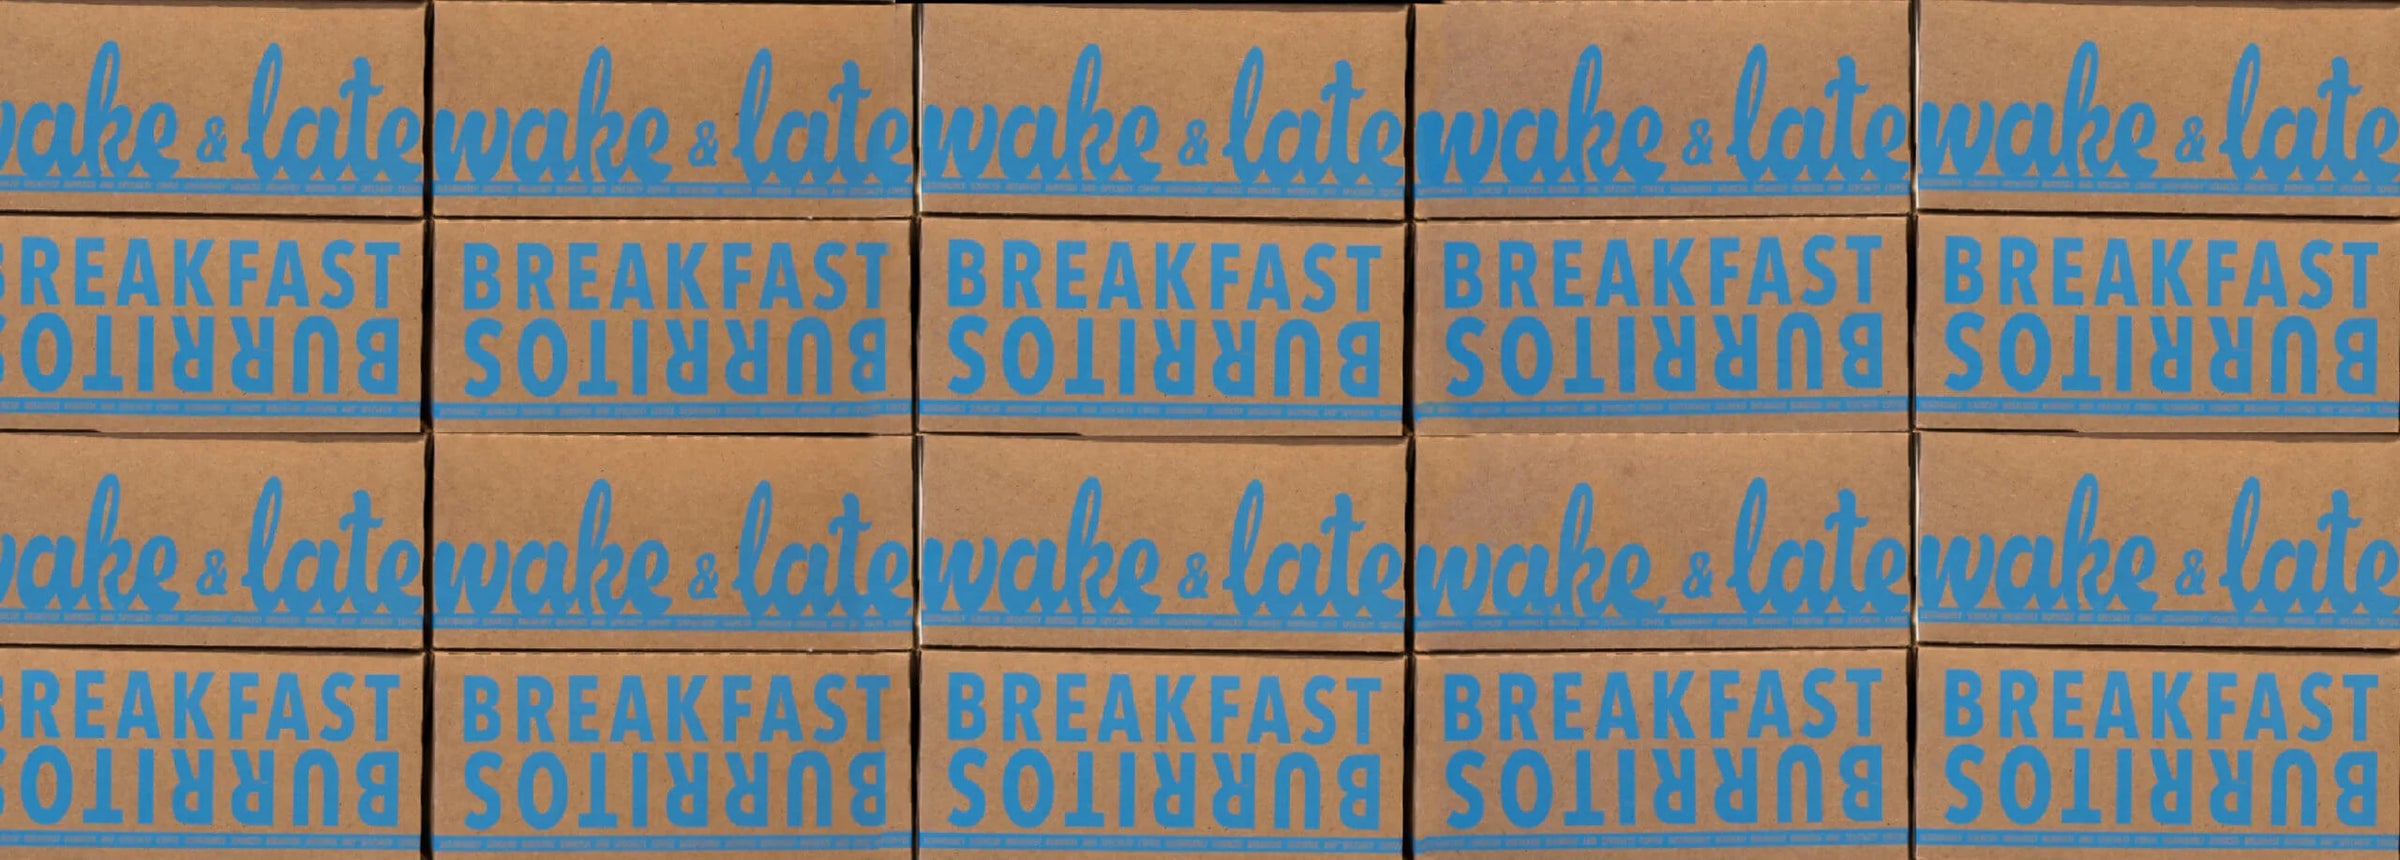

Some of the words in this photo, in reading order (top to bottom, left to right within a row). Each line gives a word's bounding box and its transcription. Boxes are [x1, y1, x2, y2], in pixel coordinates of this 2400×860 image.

[196, 116, 227, 162] &
[241, 43, 423, 180] late
[434, 46, 672, 183] wake
[688, 121, 718, 167] &
[732, 48, 909, 183] late
[922, 44, 1161, 182] wake
[1178, 120, 1208, 166] &
[1222, 47, 1404, 182] late
[1416, 44, 1666, 182] wake
[1682, 119, 1713, 165] &
[1726, 44, 1908, 182] late
[1918, 41, 2158, 180] wake
[2175, 116, 2205, 162] &
[2219, 43, 2400, 180] late
[0, 237, 400, 309] REAKFAST
[464, 242, 888, 310] BREAKFAST
[948, 239, 1381, 312] BREAKFAST
[1444, 235, 1882, 308] BREAKFAST
[1945, 236, 2378, 309] BREAKFAST
[0, 312, 398, 394] BURRITO
[464, 317, 886, 397] BURRITOS
[948, 315, 1380, 397] BURRITOS
[1446, 312, 1882, 393] BURRITOS
[1945, 311, 2377, 394] BURRITOS
[196, 549, 227, 595] &
[241, 477, 423, 612] late
[434, 479, 671, 615] wake
[688, 553, 718, 599] &
[732, 481, 909, 615] late
[922, 477, 1161, 615] wake
[1178, 553, 1208, 599] &
[1222, 480, 1404, 615] late
[1416, 483, 1666, 615] wake
[1682, 551, 1712, 598] &
[1726, 477, 1908, 615] late
[1918, 474, 2158, 612] wake
[2175, 549, 2205, 595] &
[2219, 476, 2400, 612] late
[0, 670, 400, 741] REAKFAST
[464, 674, 890, 742] BREAKFAST
[948, 672, 1381, 745] BREAKFAST
[1444, 668, 1882, 741] BREAKFAST
[1945, 669, 2378, 742] BREAKFAST
[0, 745, 399, 826] BURRITO
[464, 750, 886, 830] BURRITOS
[948, 747, 1380, 830] BURRITOS
[1446, 744, 1882, 826] BURRITOS
[1945, 744, 2377, 826] BURRITOS
